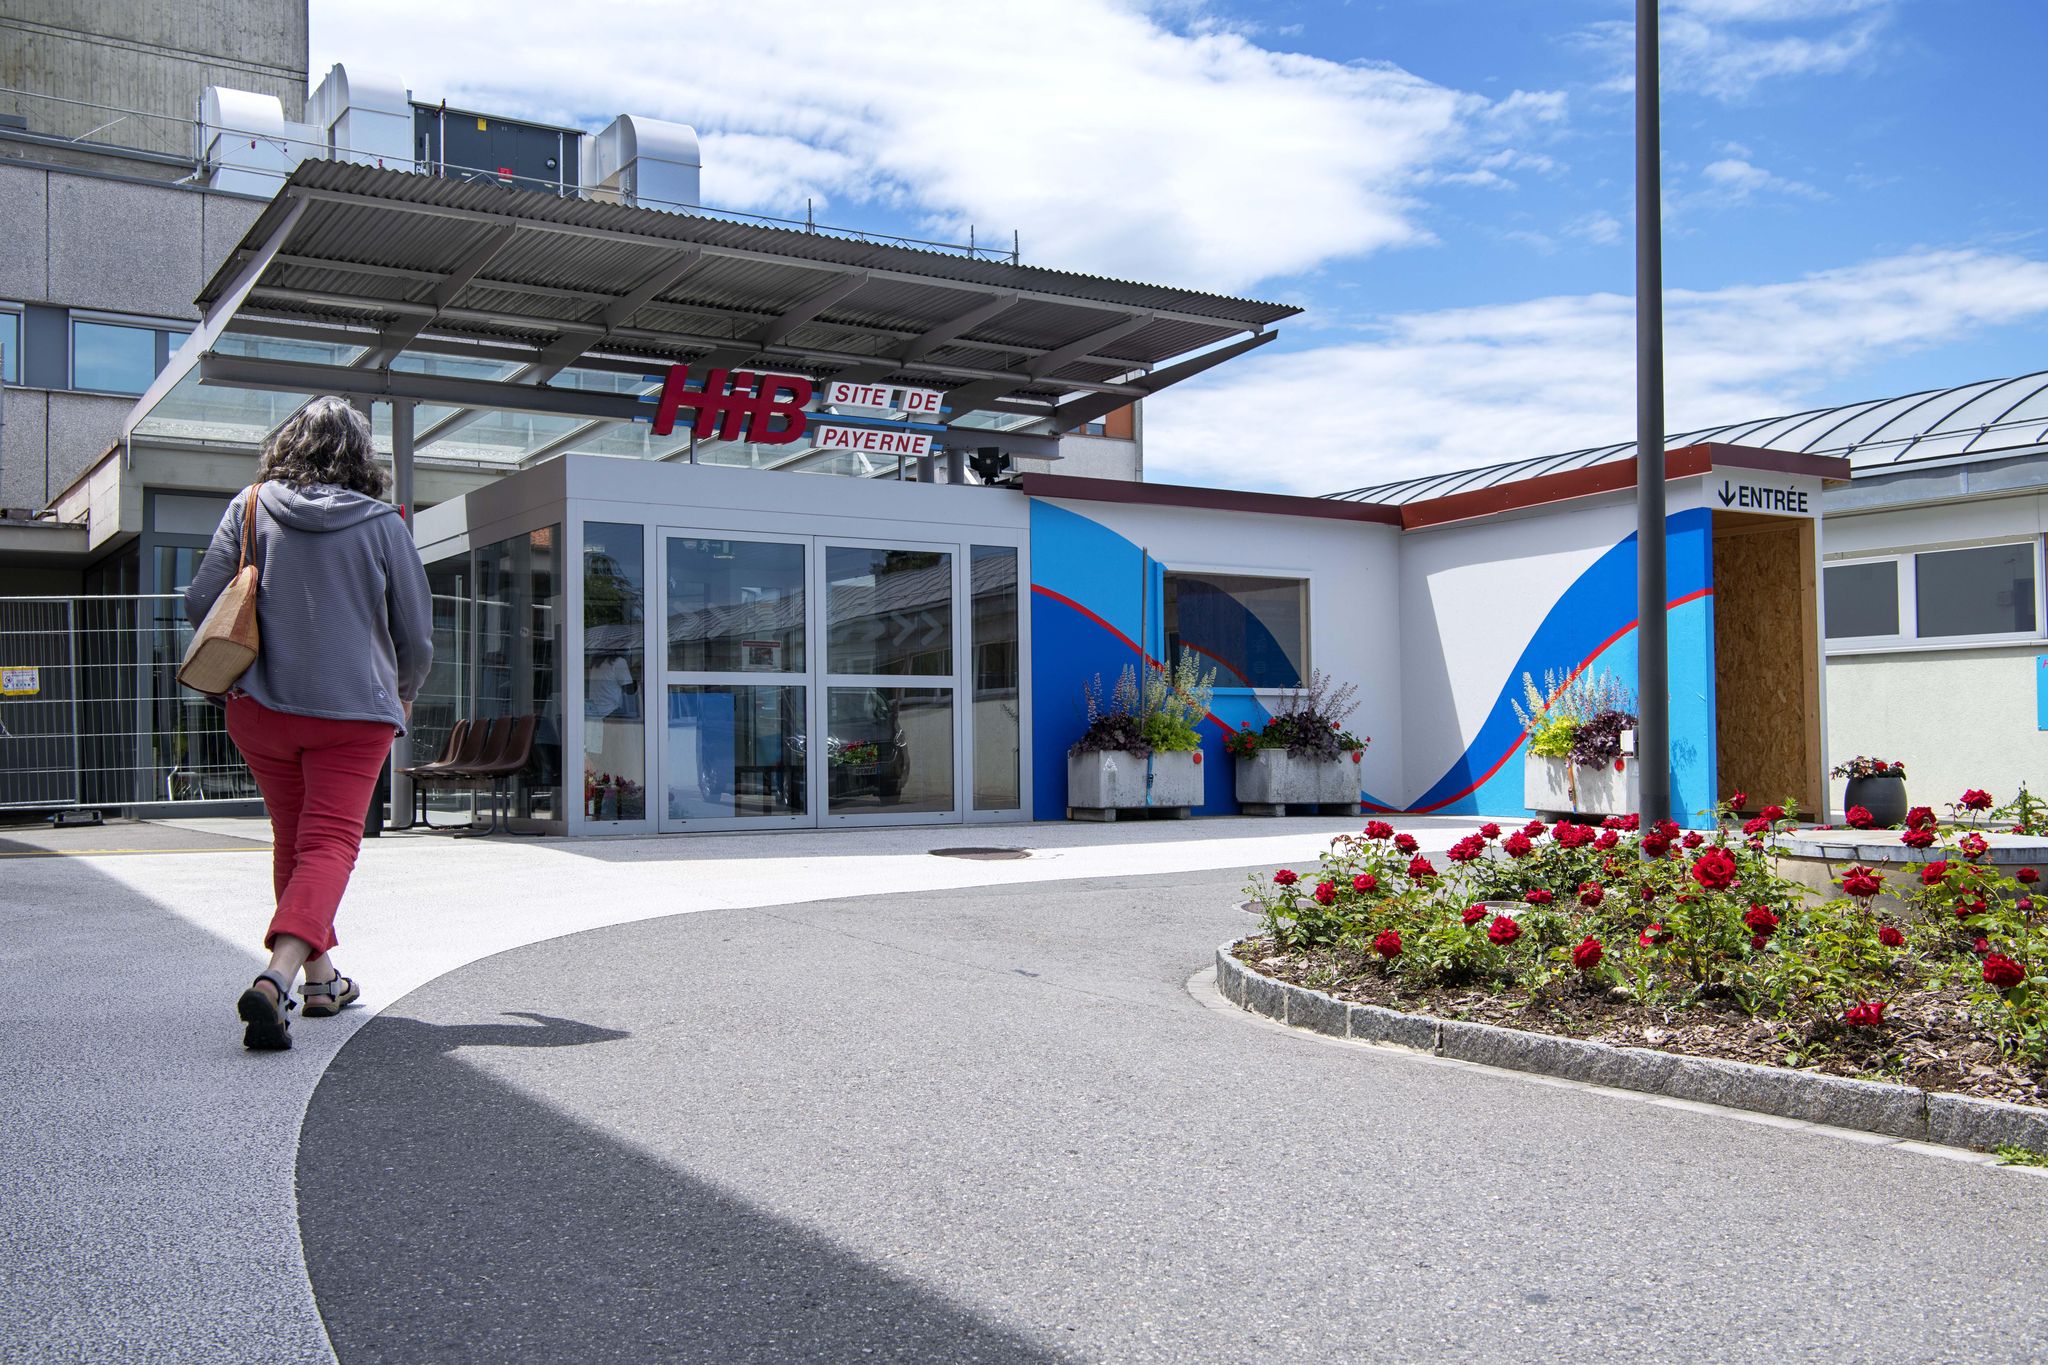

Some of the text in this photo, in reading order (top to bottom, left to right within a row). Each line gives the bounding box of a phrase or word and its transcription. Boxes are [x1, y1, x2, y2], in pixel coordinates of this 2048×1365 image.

[835, 384, 938, 411] SITE DE
[823, 428, 926, 454] PAYERNE
[1738, 485, 1808, 513] ENTRÉE
